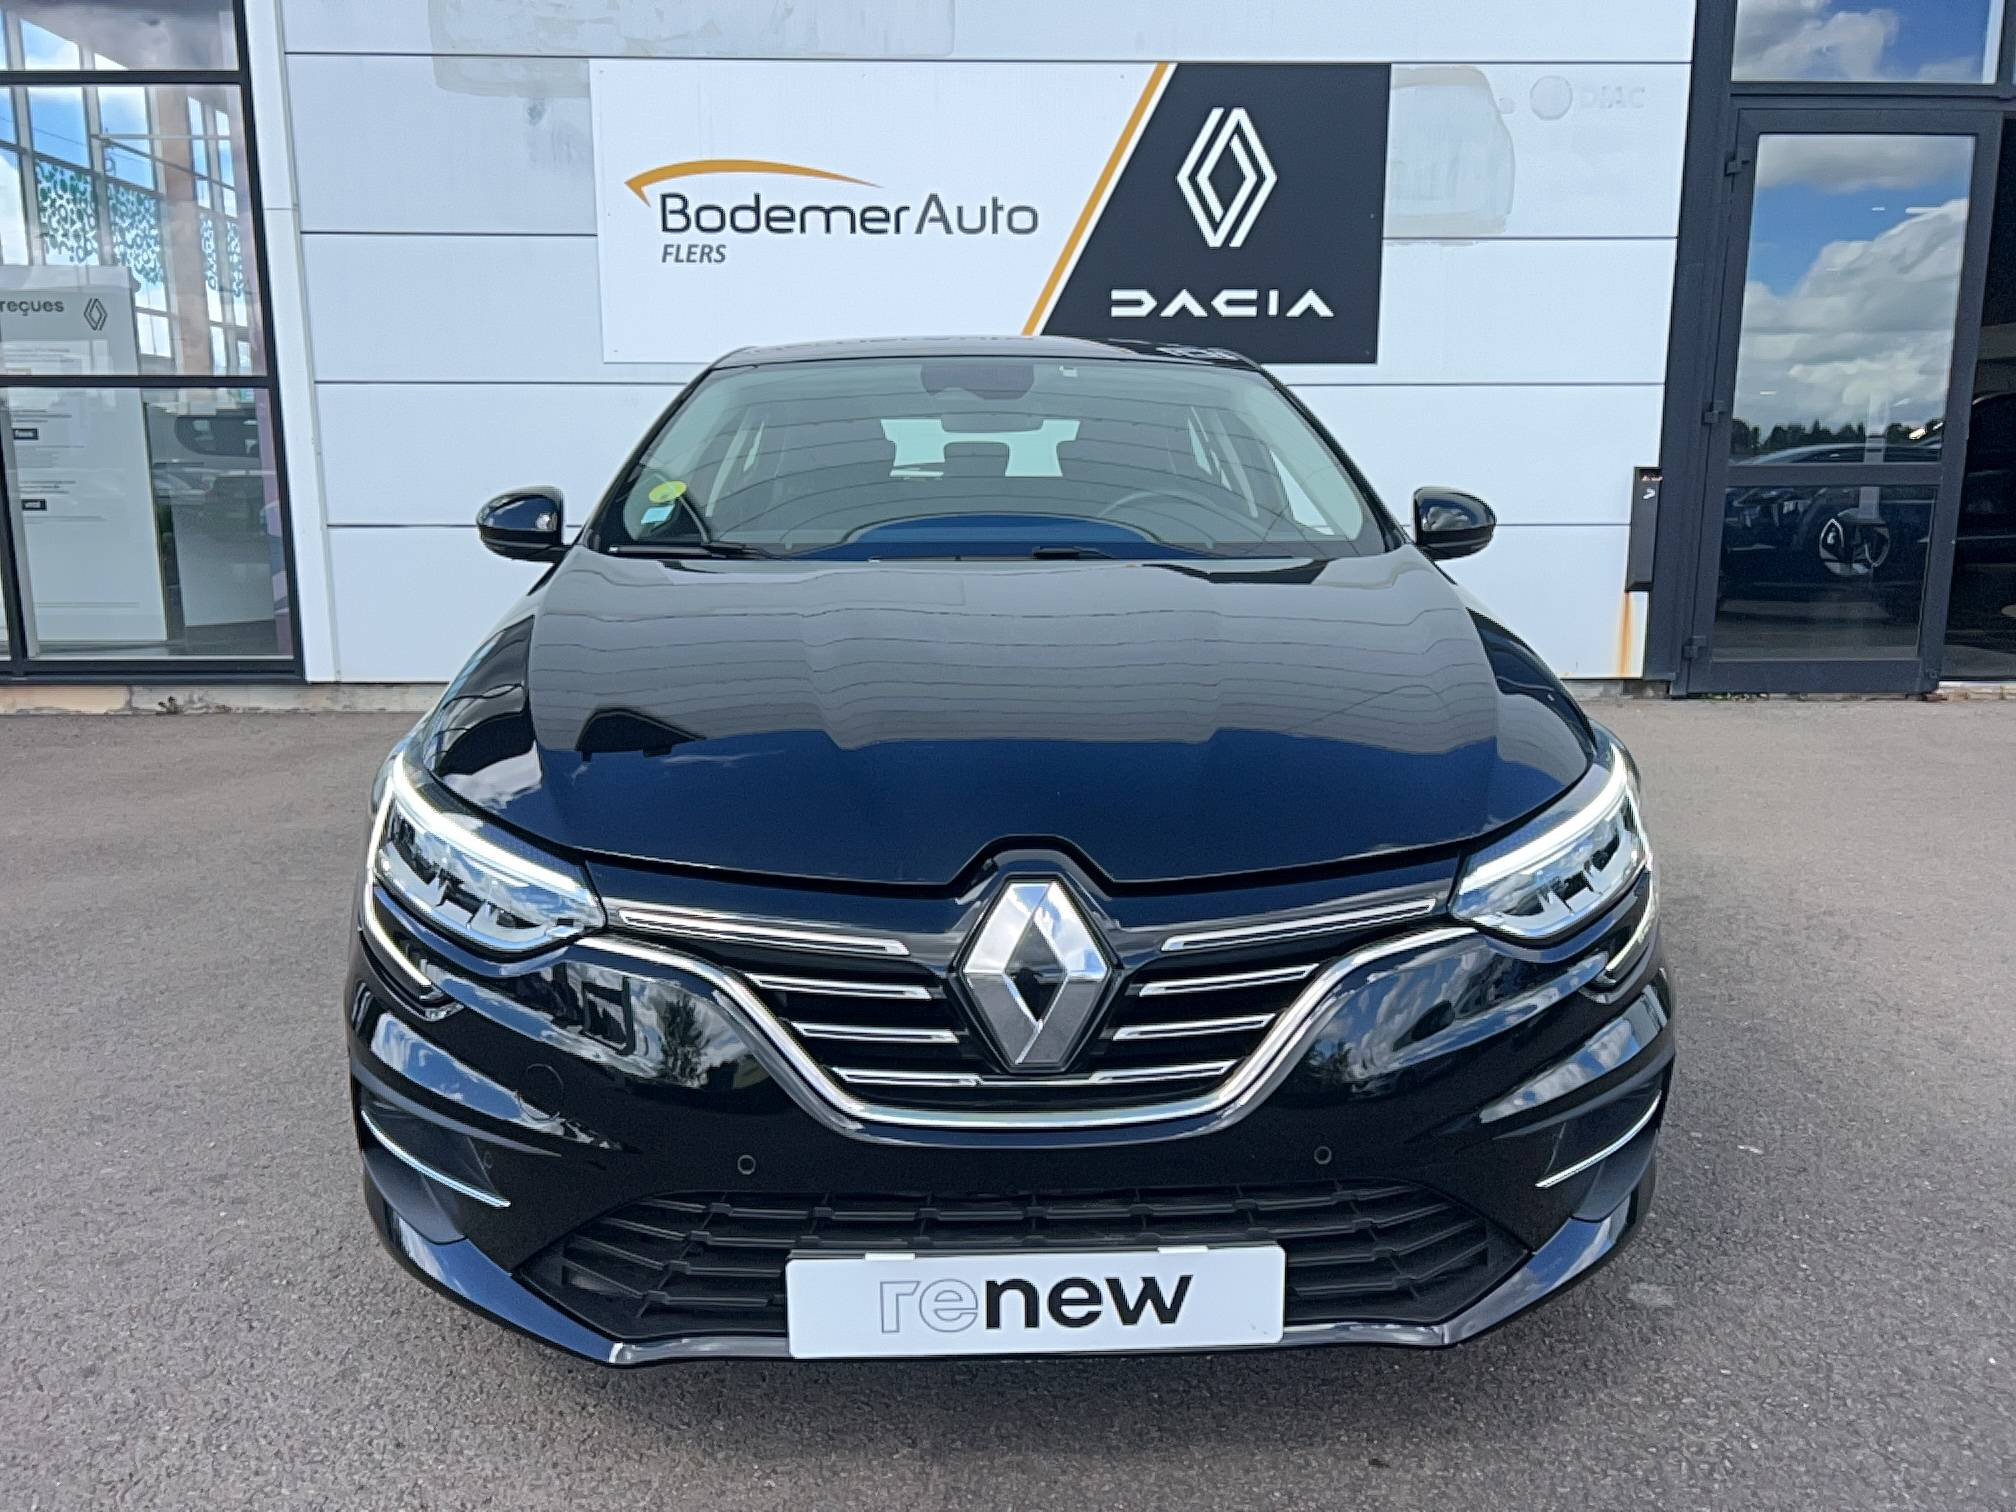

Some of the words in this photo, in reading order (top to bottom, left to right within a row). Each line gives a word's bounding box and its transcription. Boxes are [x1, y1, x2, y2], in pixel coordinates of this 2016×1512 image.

[661, 243, 727, 264] FLERS
[1110, 288, 1334, 318] DACIA
[879, 1273, 1193, 1334] renew
